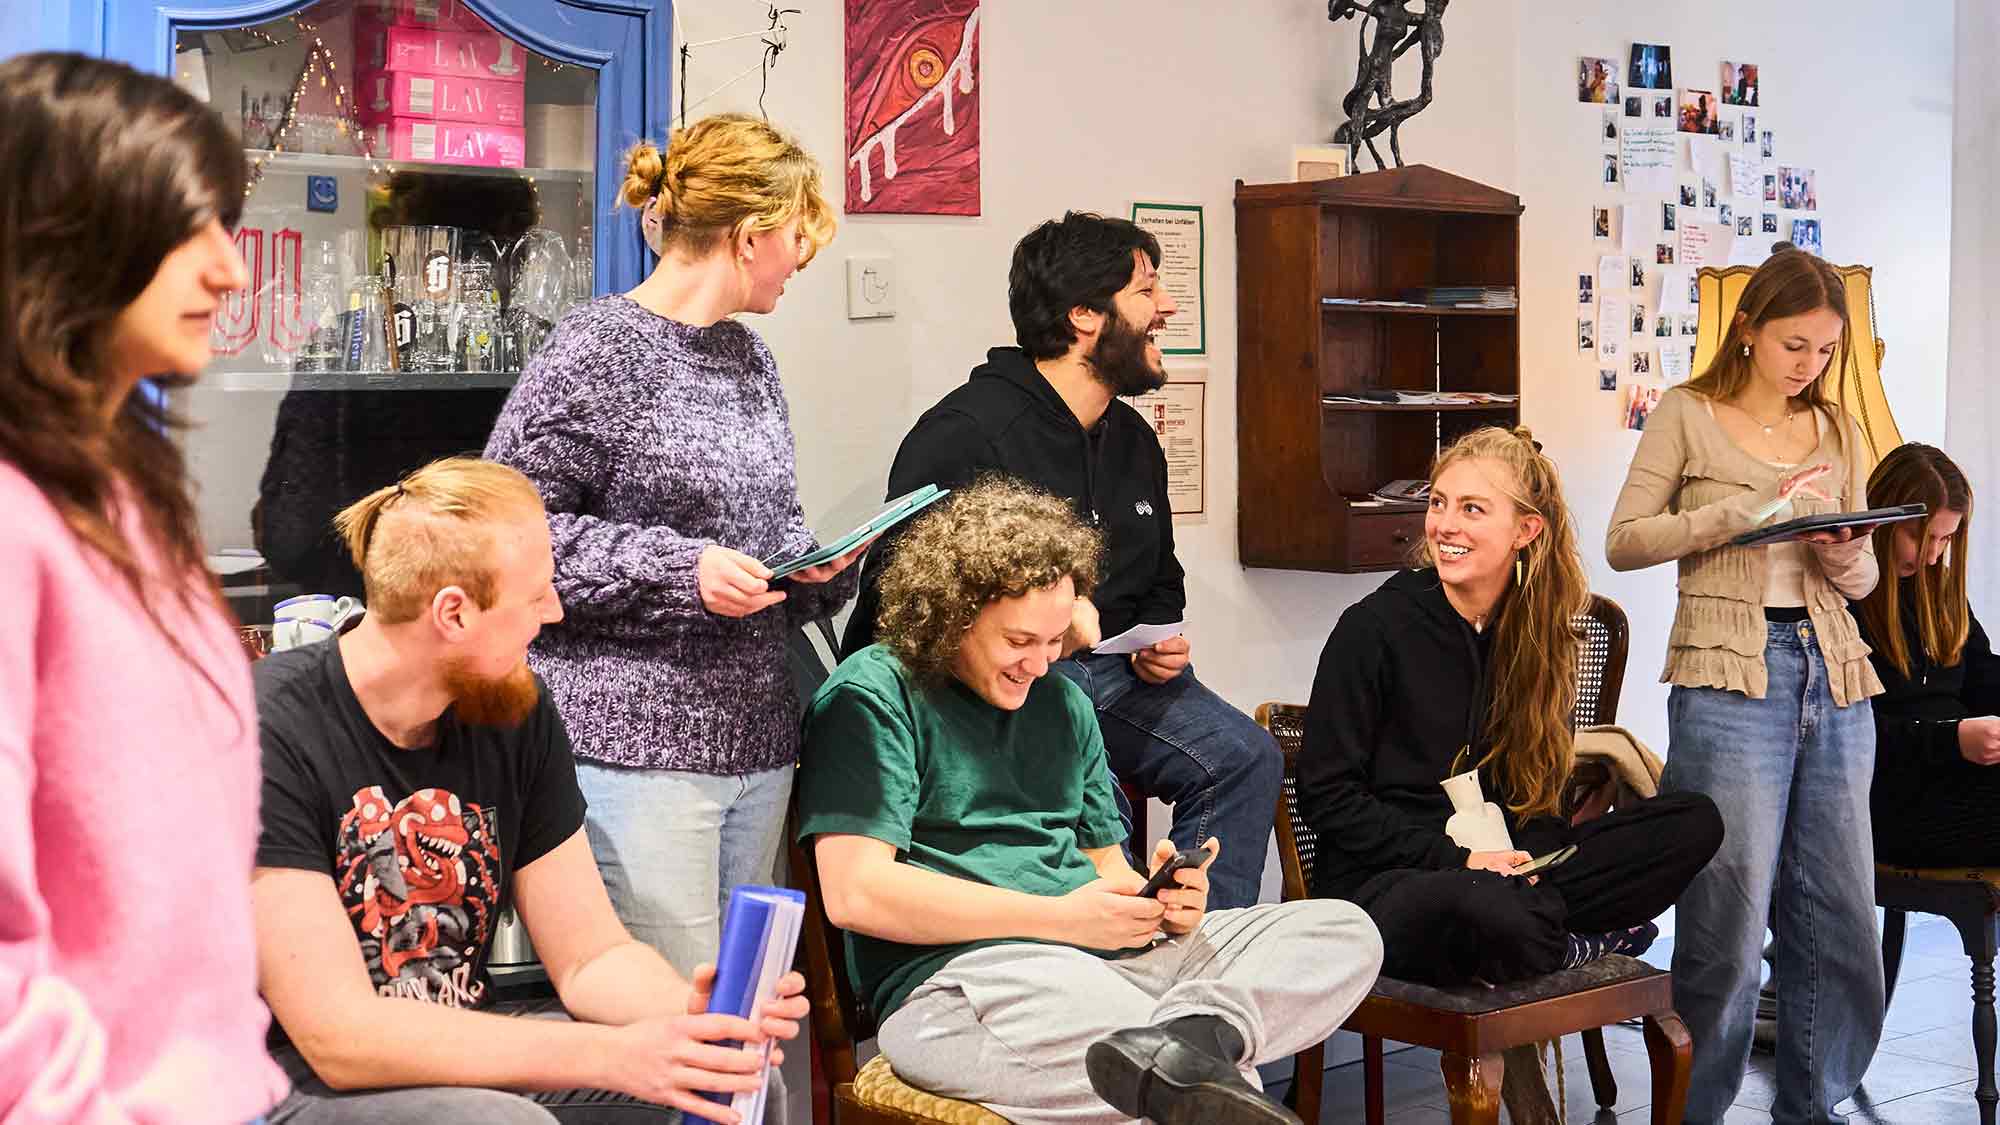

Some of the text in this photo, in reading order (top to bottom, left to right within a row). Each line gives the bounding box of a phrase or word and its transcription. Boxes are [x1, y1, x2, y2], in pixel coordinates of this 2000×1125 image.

[434, 40, 481, 70] LAV
[442, 81, 488, 113] LAV
[443, 128, 489, 159] LAV
